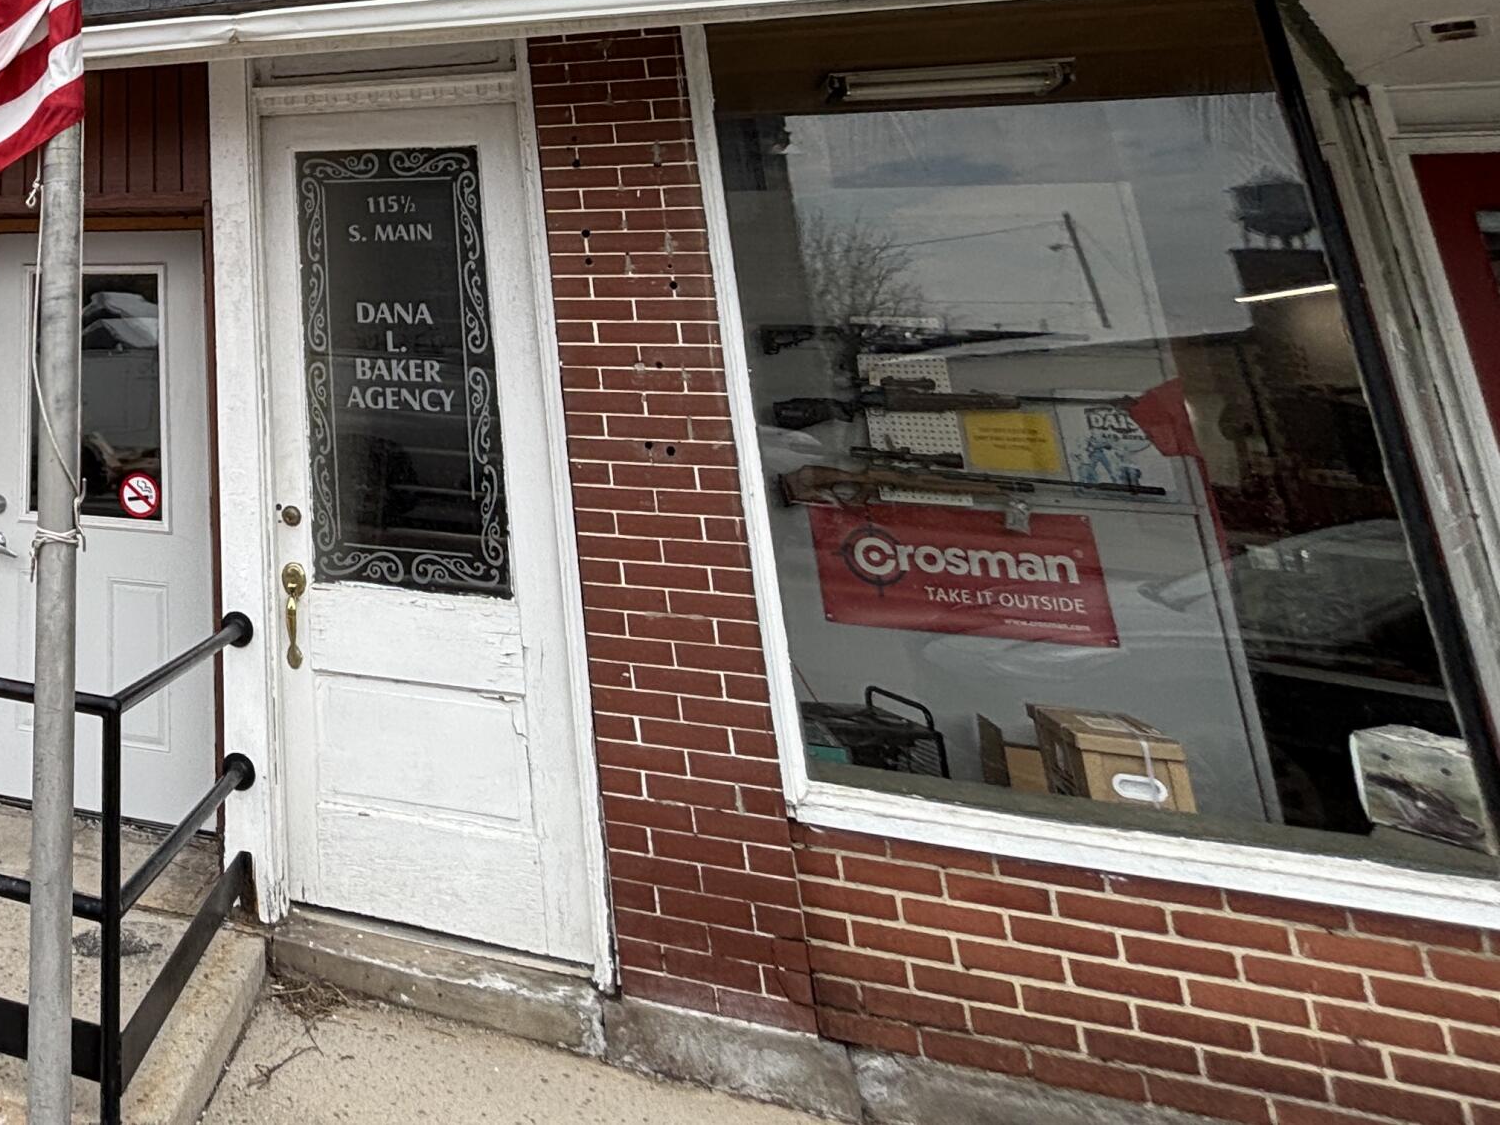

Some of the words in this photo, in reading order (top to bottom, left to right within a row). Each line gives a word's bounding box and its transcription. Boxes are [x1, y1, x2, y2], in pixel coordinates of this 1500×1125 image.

[348, 224, 368, 242] S.
[374, 223, 433, 242] MAIN
[356, 302, 434, 325] DANA
[386, 330, 408, 352] L.
[355, 357, 442, 383] BAKER
[346, 386, 455, 412] AGENCY
[1087, 413, 1140, 435] DAIS
[853, 536, 1081, 585] Crosman
[923, 585, 972, 605] TAKE
[977, 591, 995, 606] IT
[999, 593, 1088, 615] OUTSIDE
